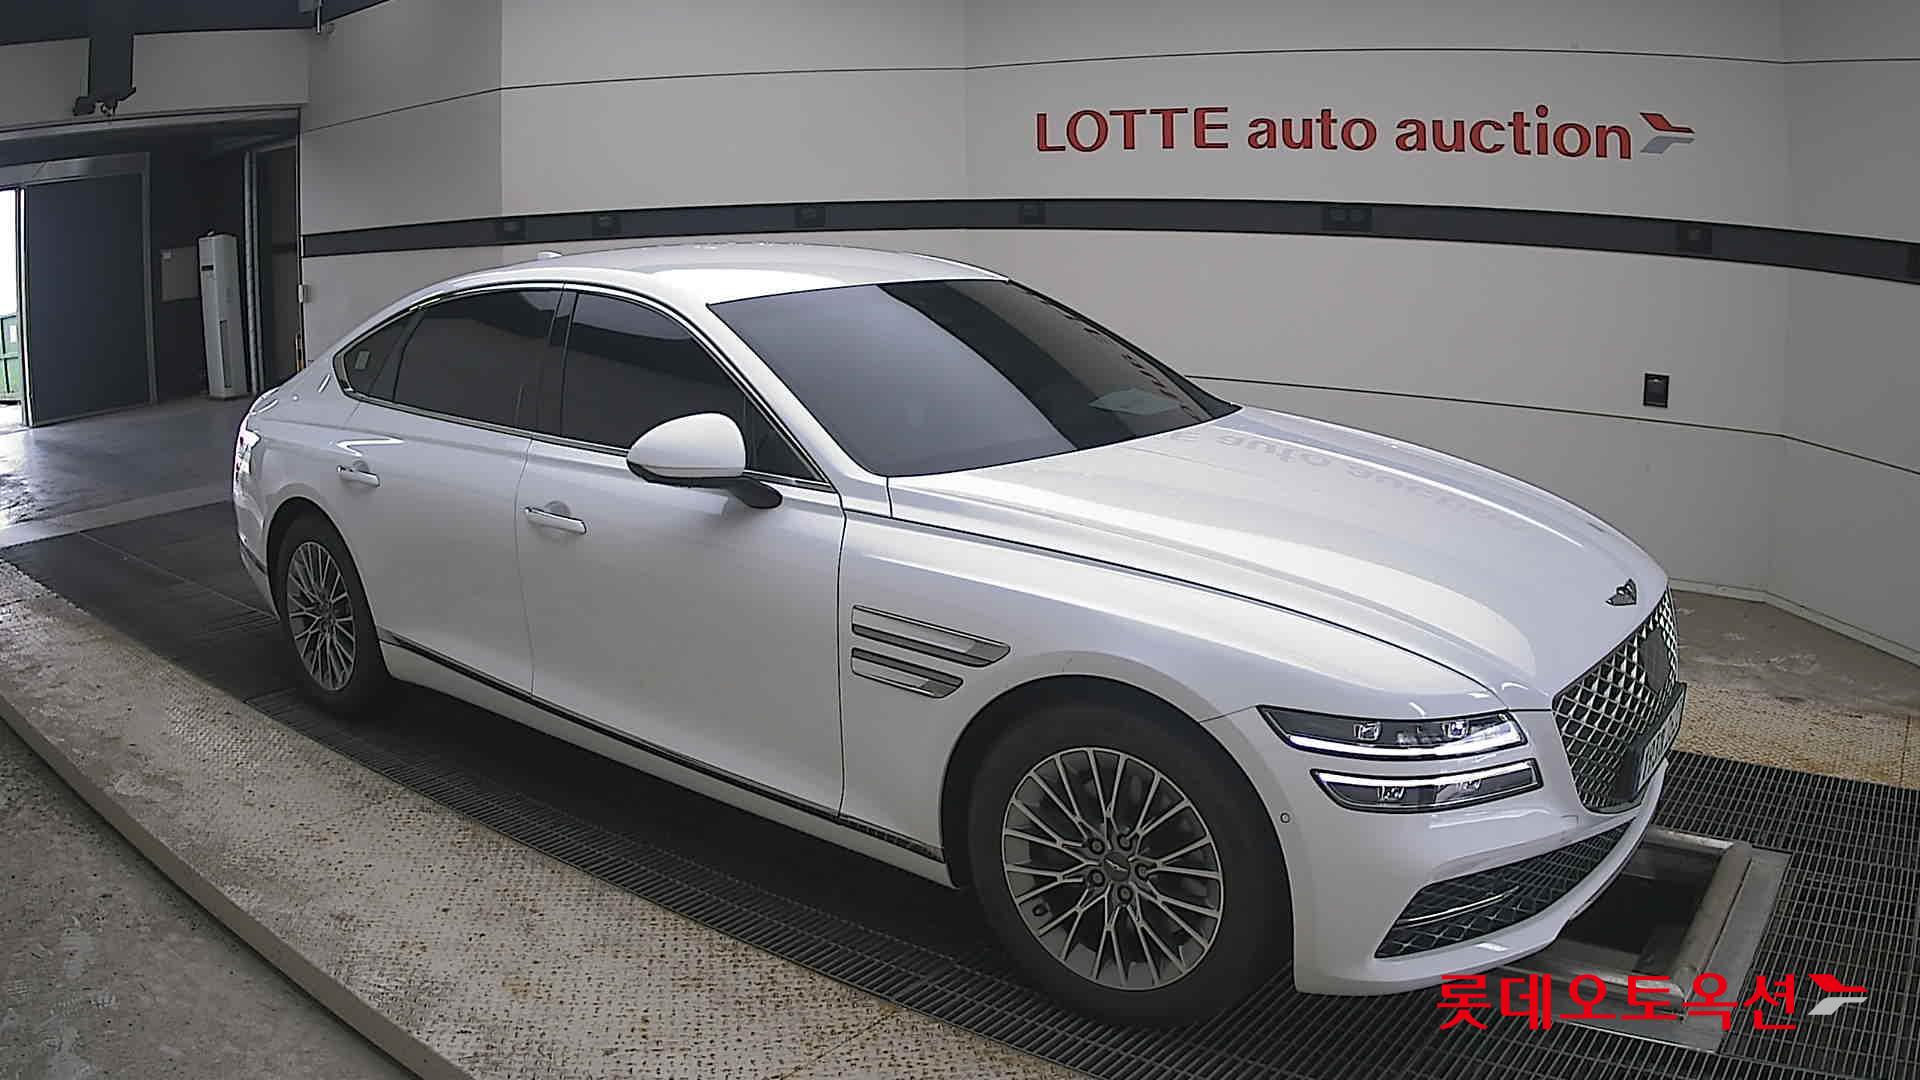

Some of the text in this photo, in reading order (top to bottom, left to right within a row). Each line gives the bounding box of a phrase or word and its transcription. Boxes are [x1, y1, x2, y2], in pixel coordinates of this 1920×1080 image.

[1036, 104, 1633, 159] LOTTE auto auction
